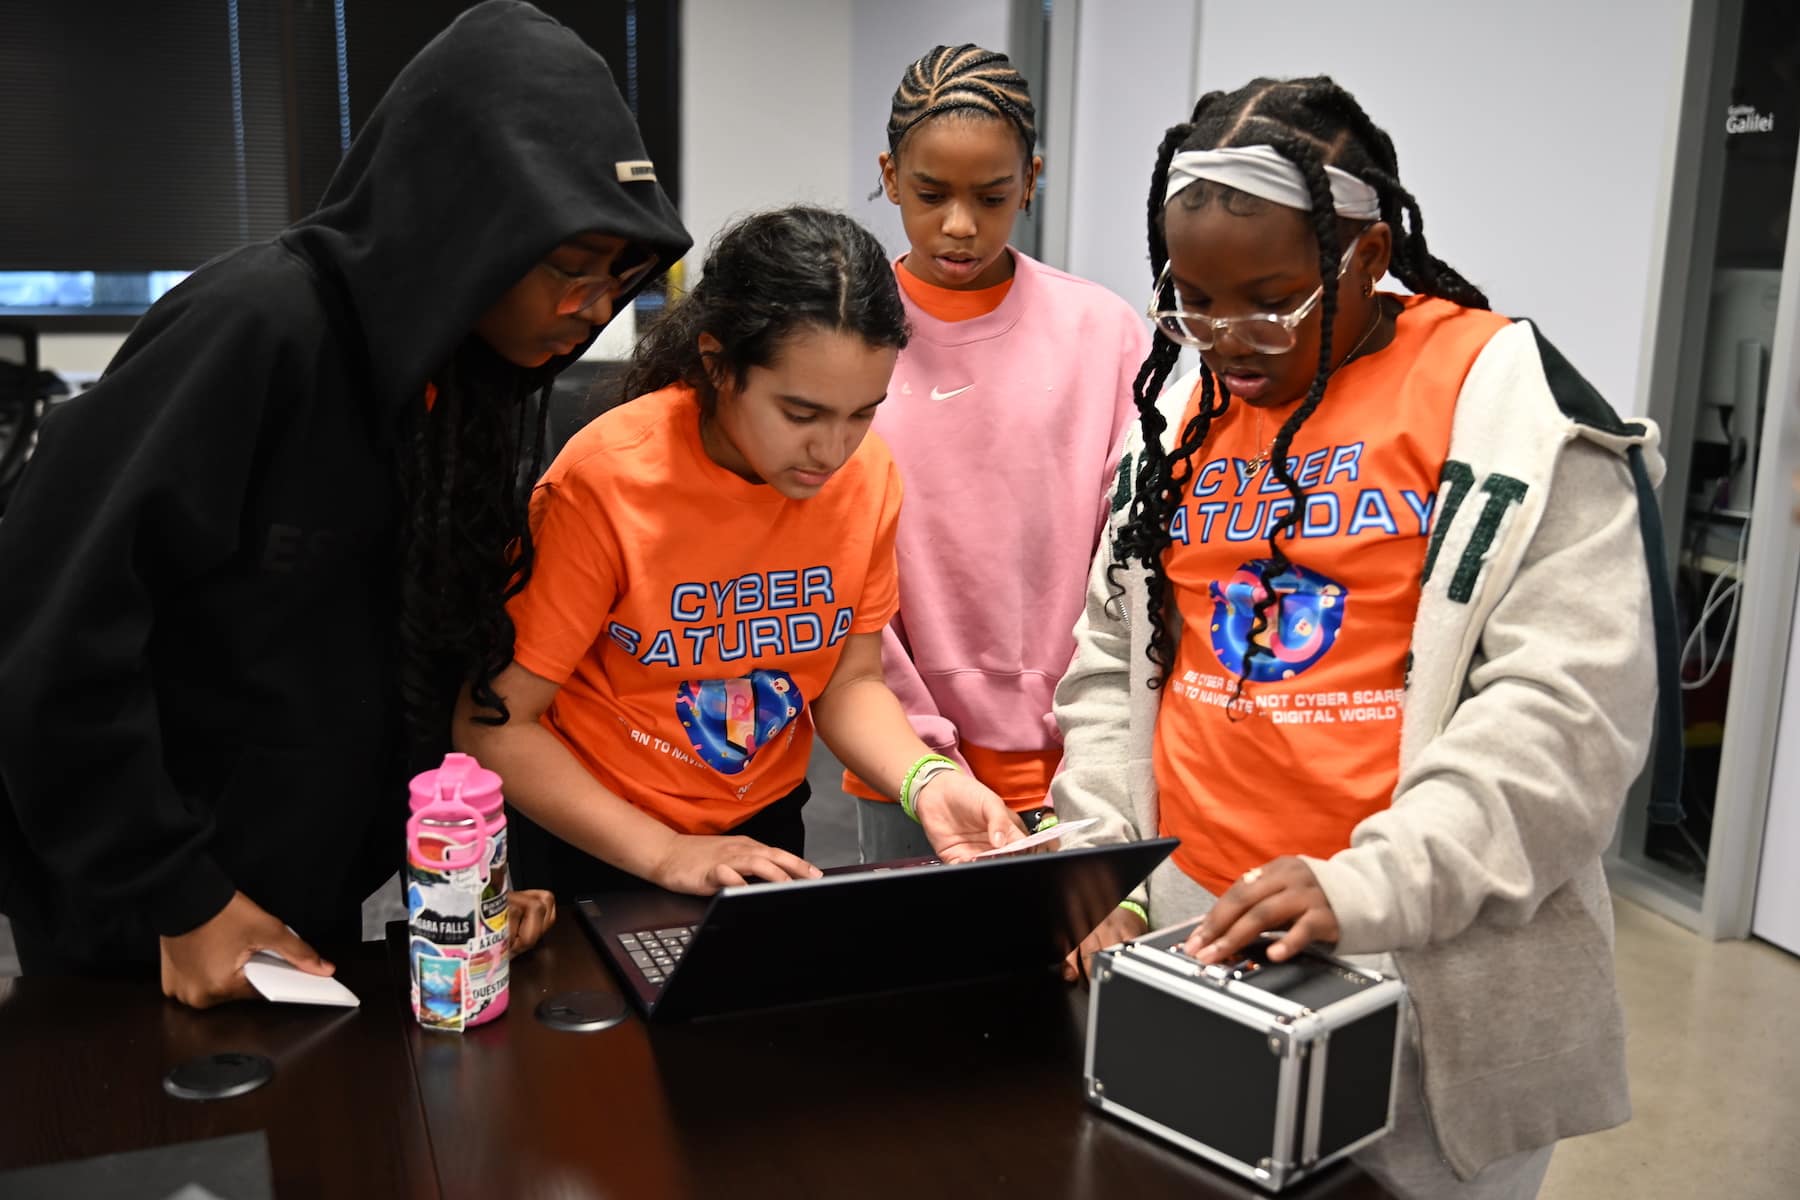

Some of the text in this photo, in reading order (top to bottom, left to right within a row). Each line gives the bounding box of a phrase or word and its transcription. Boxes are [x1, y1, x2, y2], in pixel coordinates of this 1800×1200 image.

[1193, 441, 1365, 498] CYBER
[1168, 488, 1436, 546] ATURDAY
[671, 565, 835, 623] CYBER
[608, 607, 853, 667] SATURDA
[1185, 685, 1199, 699] TO
[1199, 689, 1255, 714] NAVIGATE
[1271, 709, 1335, 724] DIGITAL
[1339, 706, 1398, 722] WORLD
[1256, 694, 1290, 707] NOT
[1294, 692, 1349, 707] CYBER
[1352, 689, 1404, 705] SCARE
[654, 738, 671, 754] TO
[440, 921, 470, 934] FALLS
